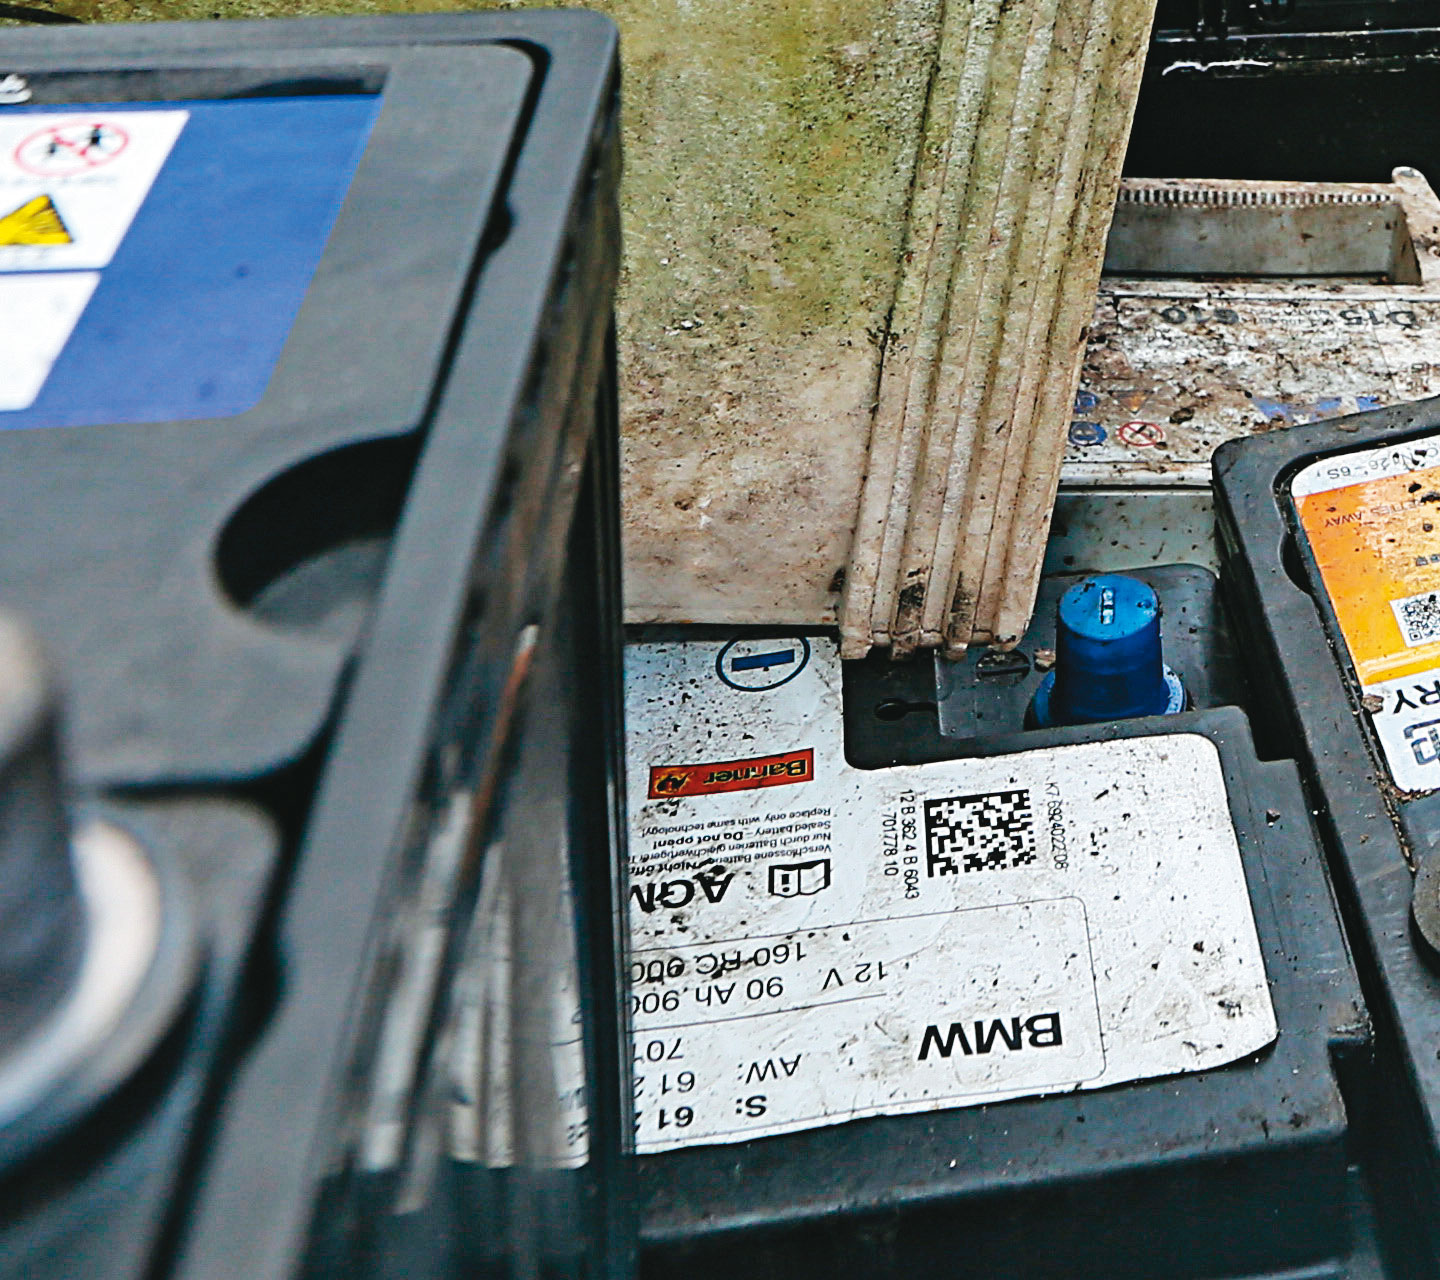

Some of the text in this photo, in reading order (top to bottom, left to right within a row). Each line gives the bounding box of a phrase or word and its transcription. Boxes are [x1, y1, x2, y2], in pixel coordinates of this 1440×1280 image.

[1324, 511, 1363, 528] AWAY
[703, 759, 808, 784] Banner
[641, 807, 831, 838] Replace only with same technology!
[755, 823, 794, 837] battery
[795, 820, 831, 832] Sealed
[725, 831, 744, 840] Do
[729, 839, 779, 852] Batterien
[882, 812, 899, 876] 701778 10
[752, 844, 832, 862] Verschlossene
[904, 844, 917, 852] 4
[904, 869, 920, 900] 6043
[695, 949, 742, 976] RC
[753, 940, 807, 968] 160
[821, 967, 846, 991] V
[855, 960, 889, 984] 12
[695, 982, 738, 1007] Ah
[746, 976, 784, 1001] 90
[918, 1011, 1064, 1063] BMW
[737, 1053, 803, 1085] AW:
[661, 1070, 696, 1096] 61
[657, 1106, 694, 1130] 61
[735, 1095, 768, 1118] S:
